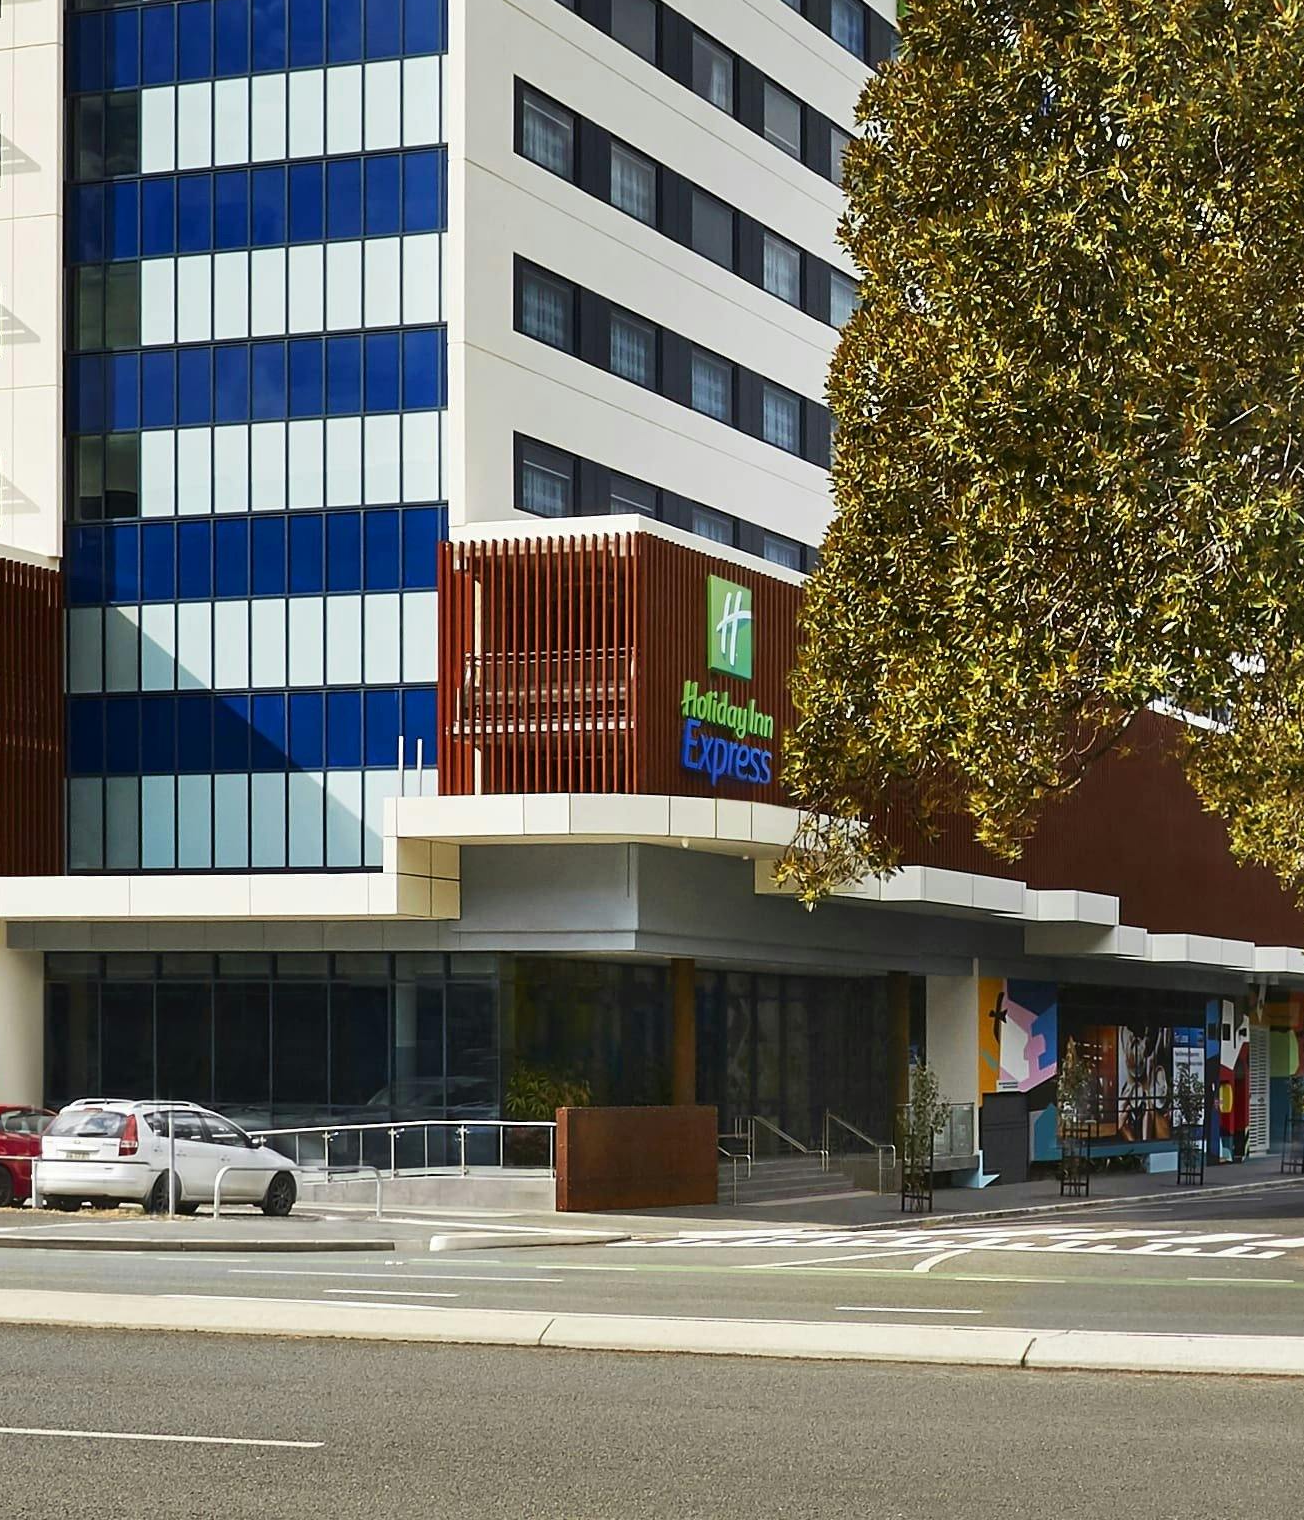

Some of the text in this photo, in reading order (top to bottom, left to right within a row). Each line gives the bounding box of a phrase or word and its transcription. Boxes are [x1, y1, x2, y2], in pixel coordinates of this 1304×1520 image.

[681, 680, 773, 740] Holiday Inn
[681, 719, 772, 787] Express
